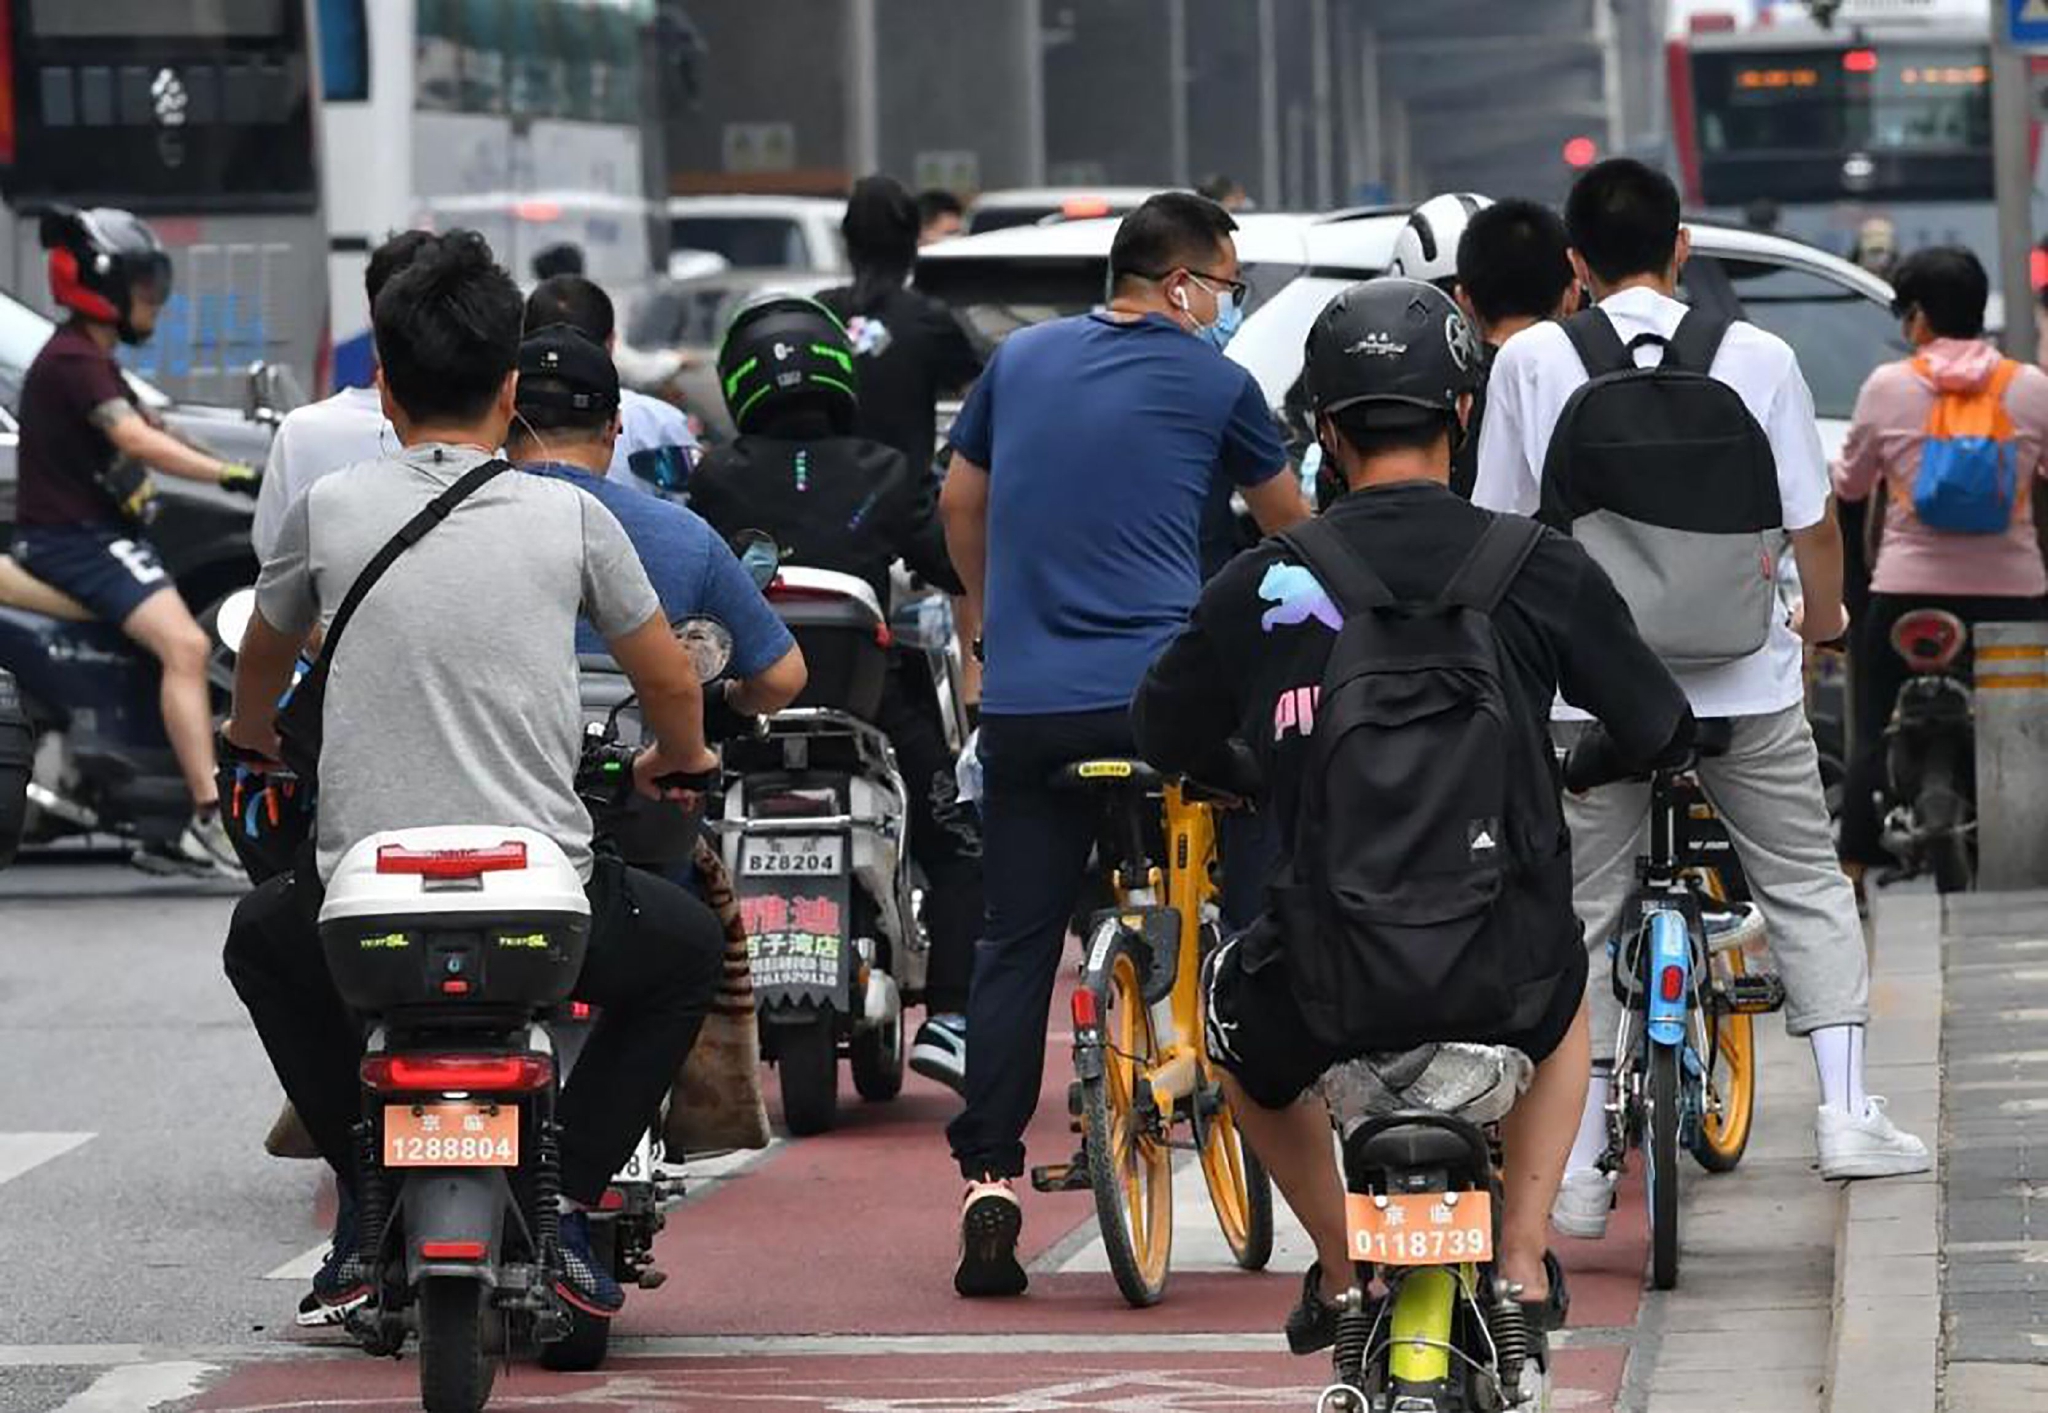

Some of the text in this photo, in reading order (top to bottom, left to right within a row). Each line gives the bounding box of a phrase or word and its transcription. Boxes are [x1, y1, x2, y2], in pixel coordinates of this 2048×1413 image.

[749, 854, 833, 871] BZ8204
[392, 1137, 511, 1161] 1288804
[1355, 1228, 1484, 1259] 0118739
